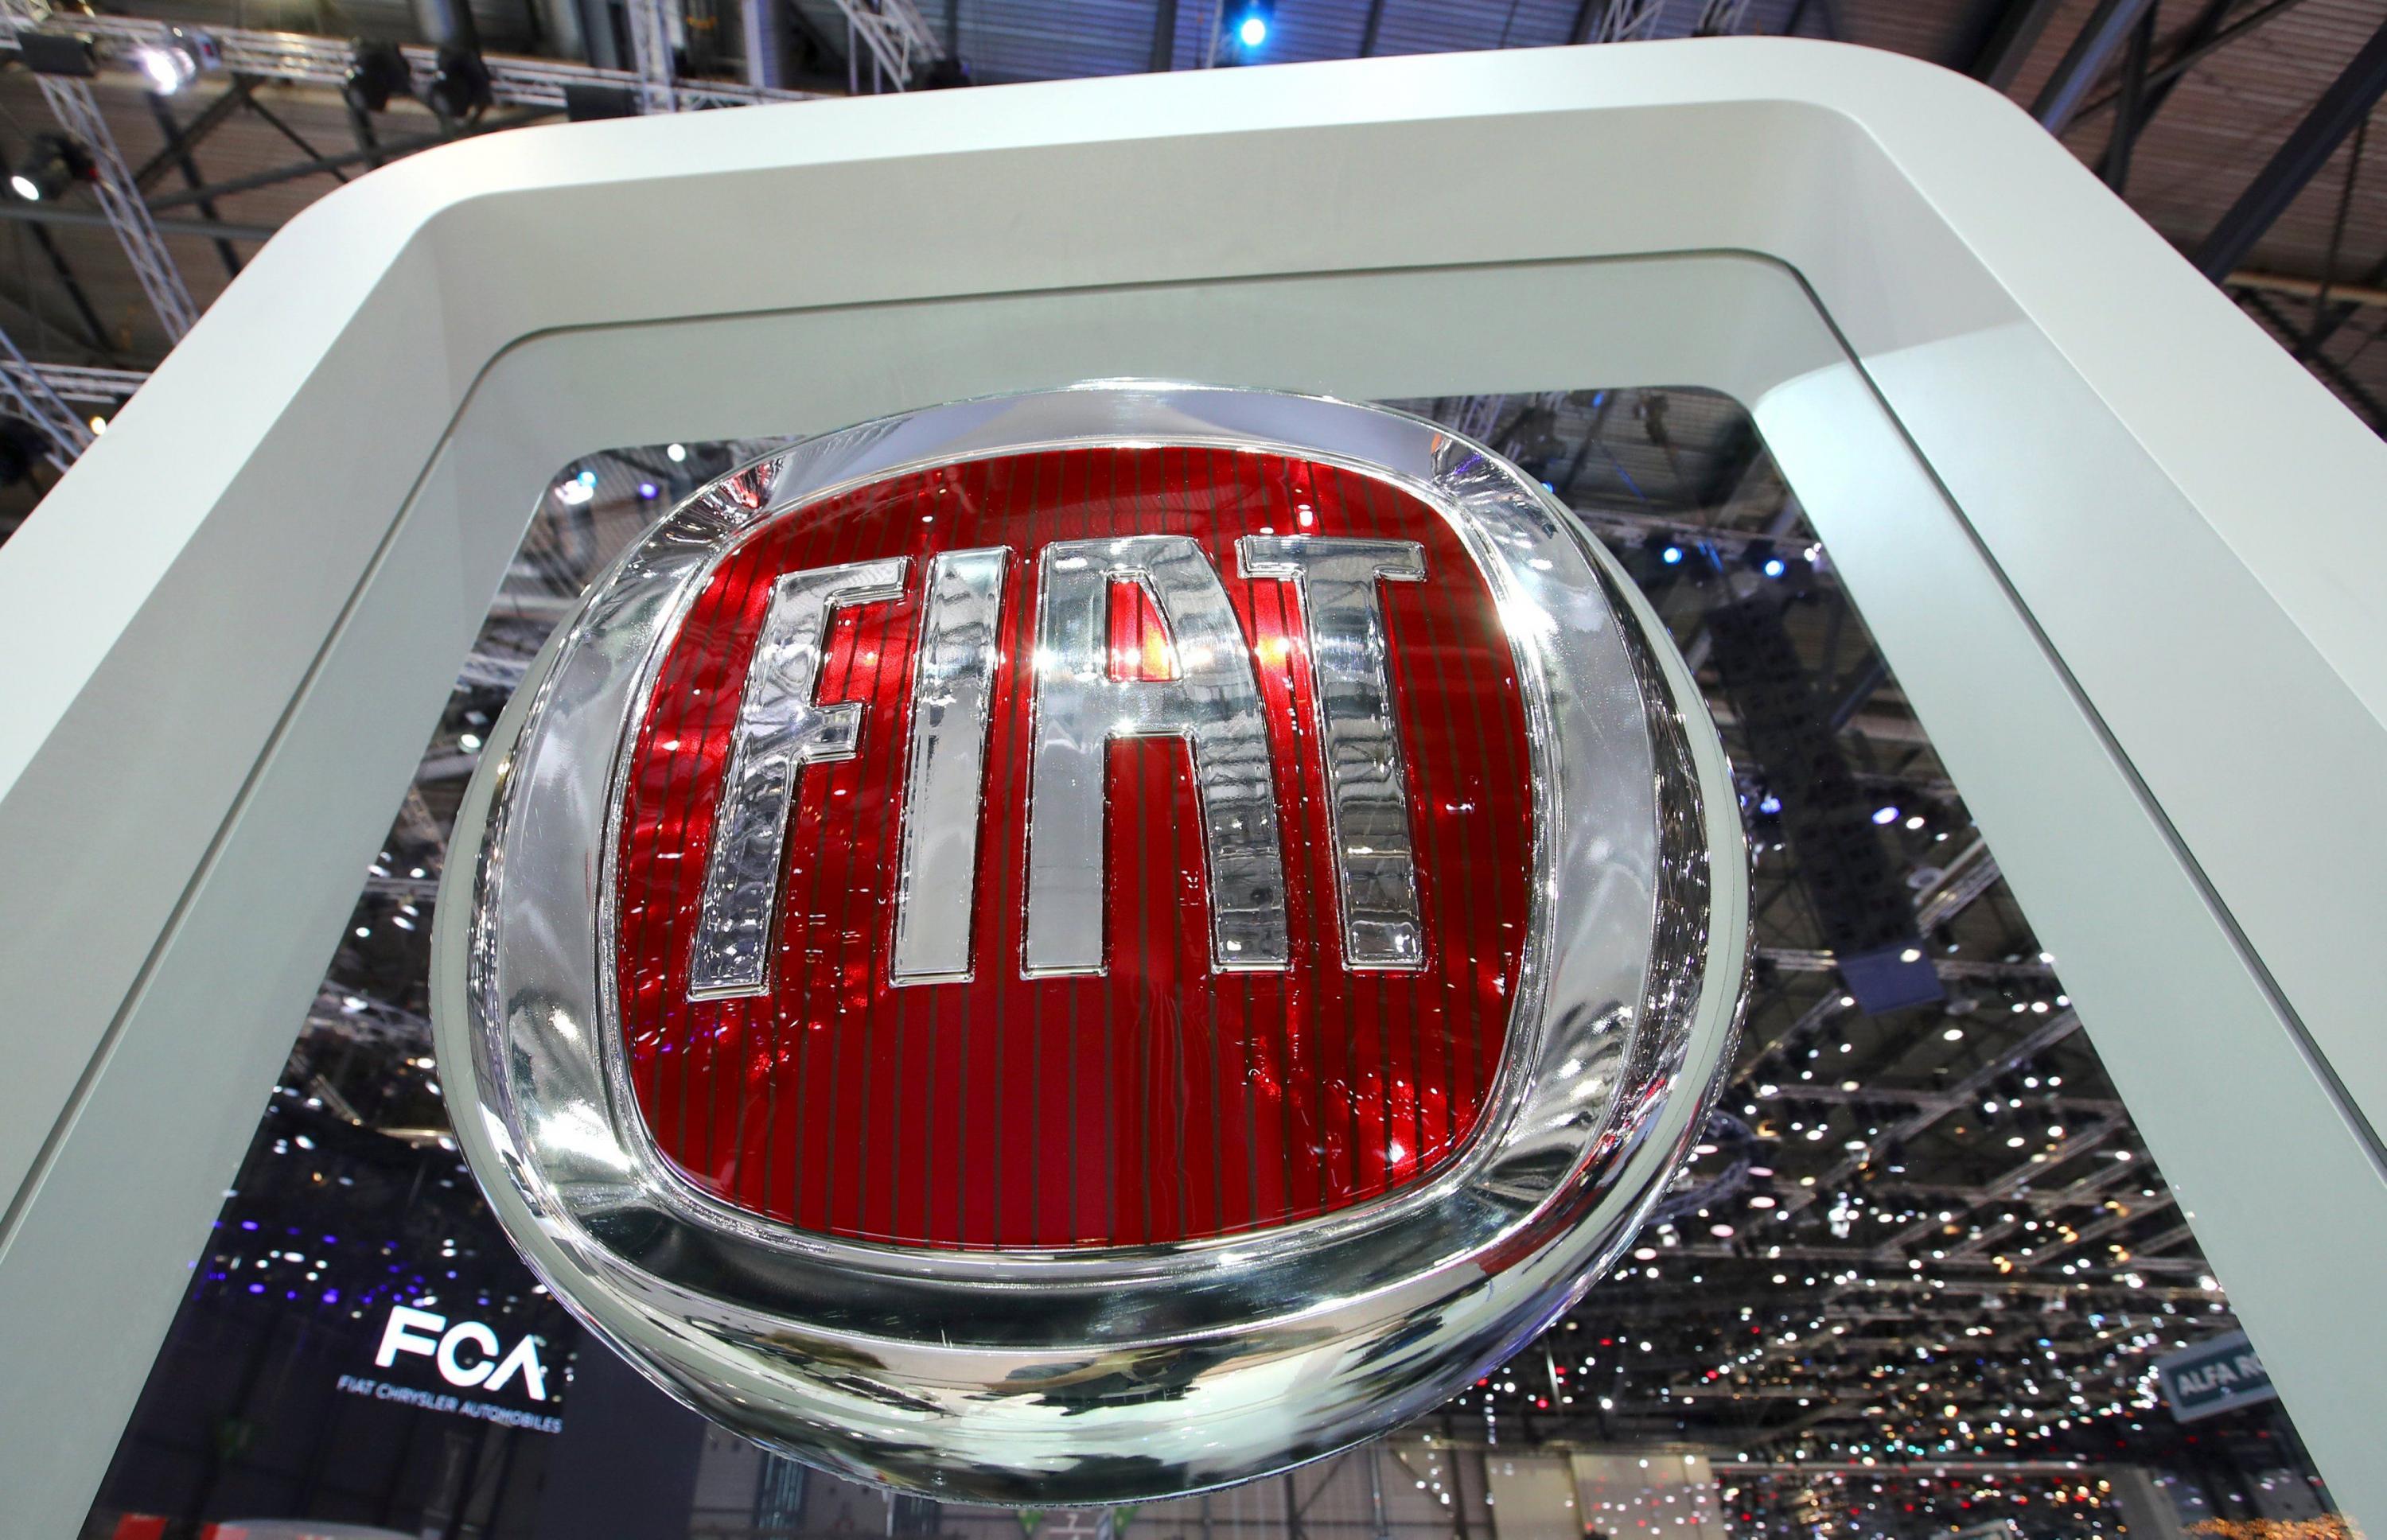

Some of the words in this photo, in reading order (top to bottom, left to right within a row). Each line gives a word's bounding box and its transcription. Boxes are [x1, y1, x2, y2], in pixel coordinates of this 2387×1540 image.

[687, 535, 1428, 1004] FIAT
[375, 1305, 546, 1401] FCA
[2177, 1361, 2239, 1396] ALFA
[336, 1375, 376, 1395] FIAT
[376, 1382, 459, 1413] CHRYSLER
[458, 1400, 563, 1433] AUTOMOBILES
